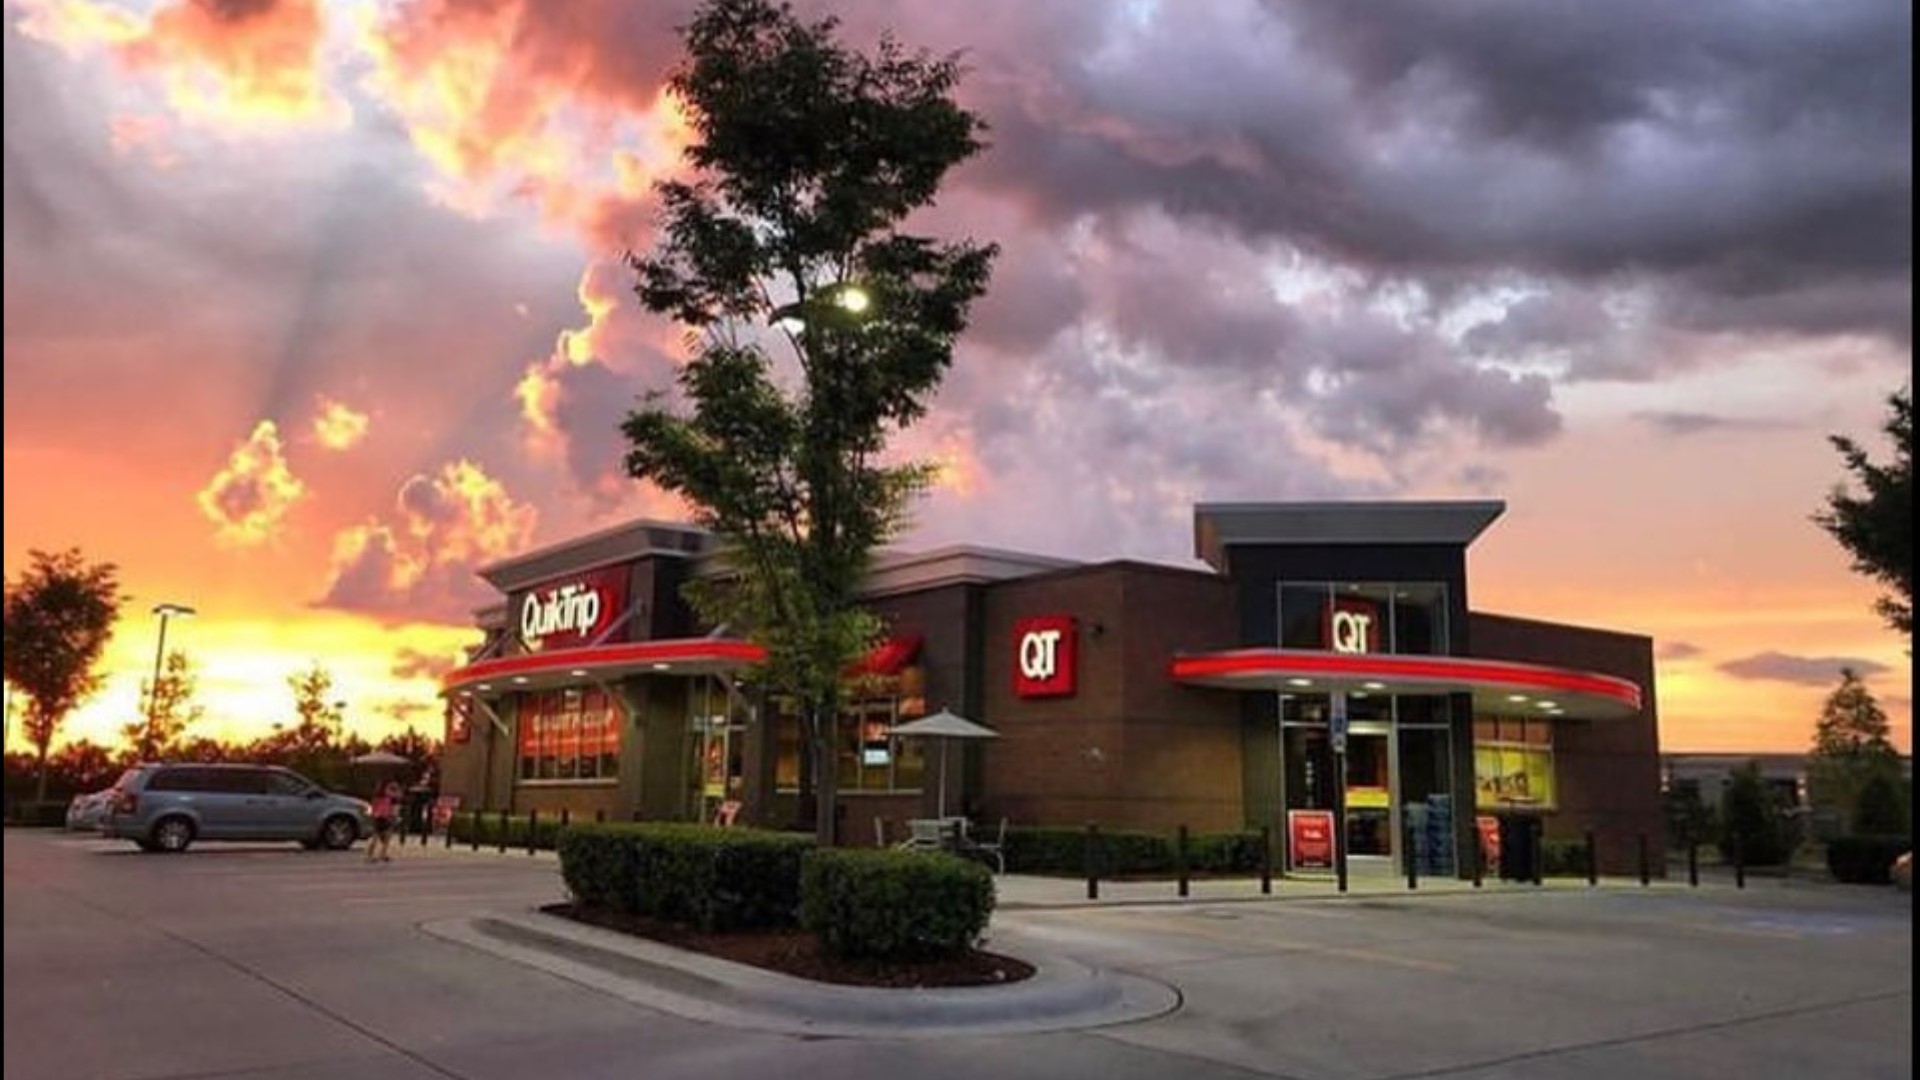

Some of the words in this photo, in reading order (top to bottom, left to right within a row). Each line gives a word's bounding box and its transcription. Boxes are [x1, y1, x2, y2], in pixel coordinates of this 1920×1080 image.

[521, 583, 599, 639] QuikTrip
[1333, 611, 1370, 653] QT
[1020, 630, 1061, 680] QT
